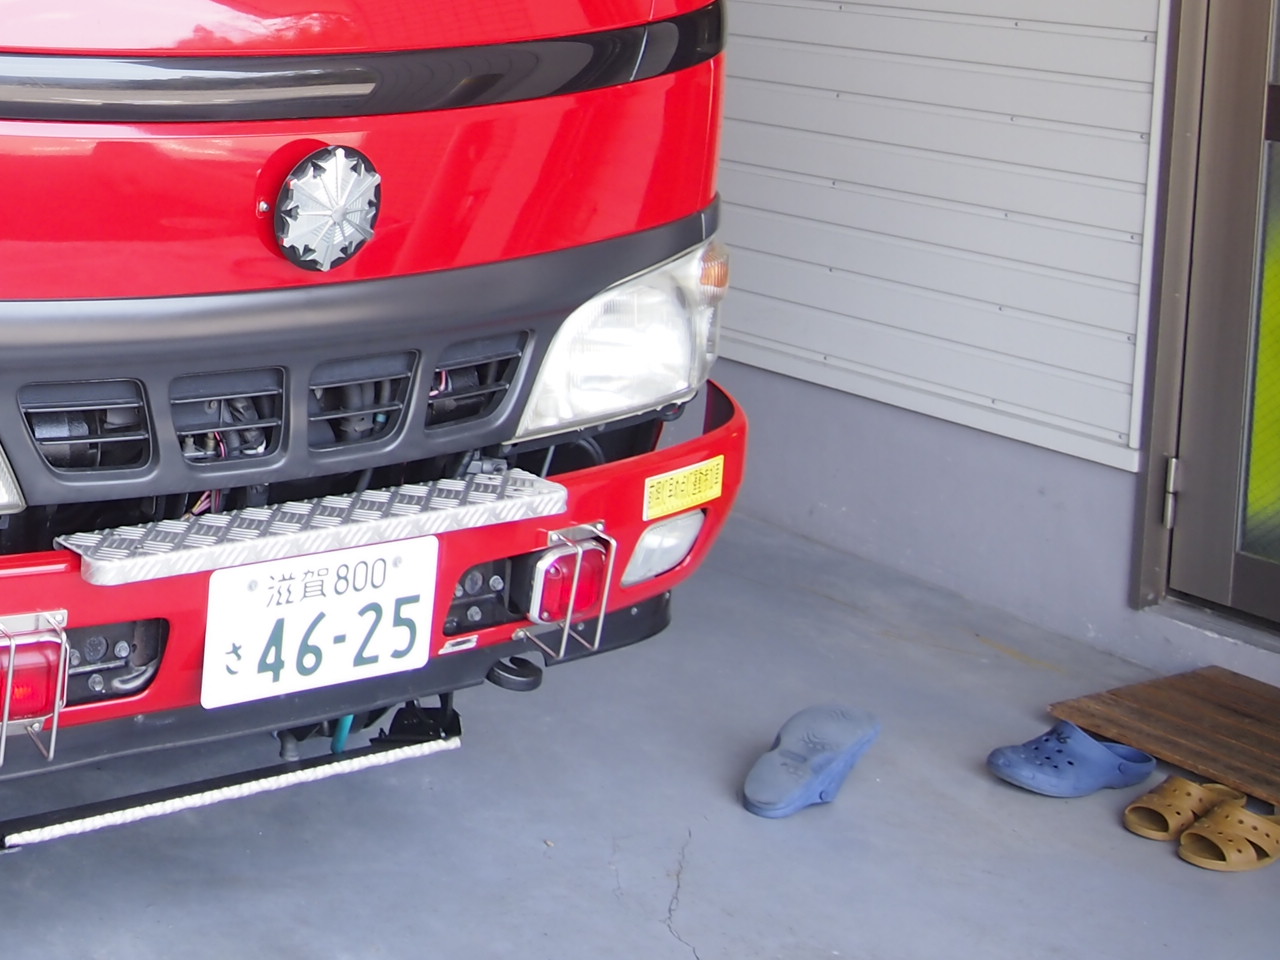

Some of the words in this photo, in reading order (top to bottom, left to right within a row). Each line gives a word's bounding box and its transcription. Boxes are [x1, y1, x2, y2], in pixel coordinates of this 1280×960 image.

[266, 557, 387, 608] 滋賀800
[225, 641, 242, 676] さ
[257, 594, 421, 683] 46-25
